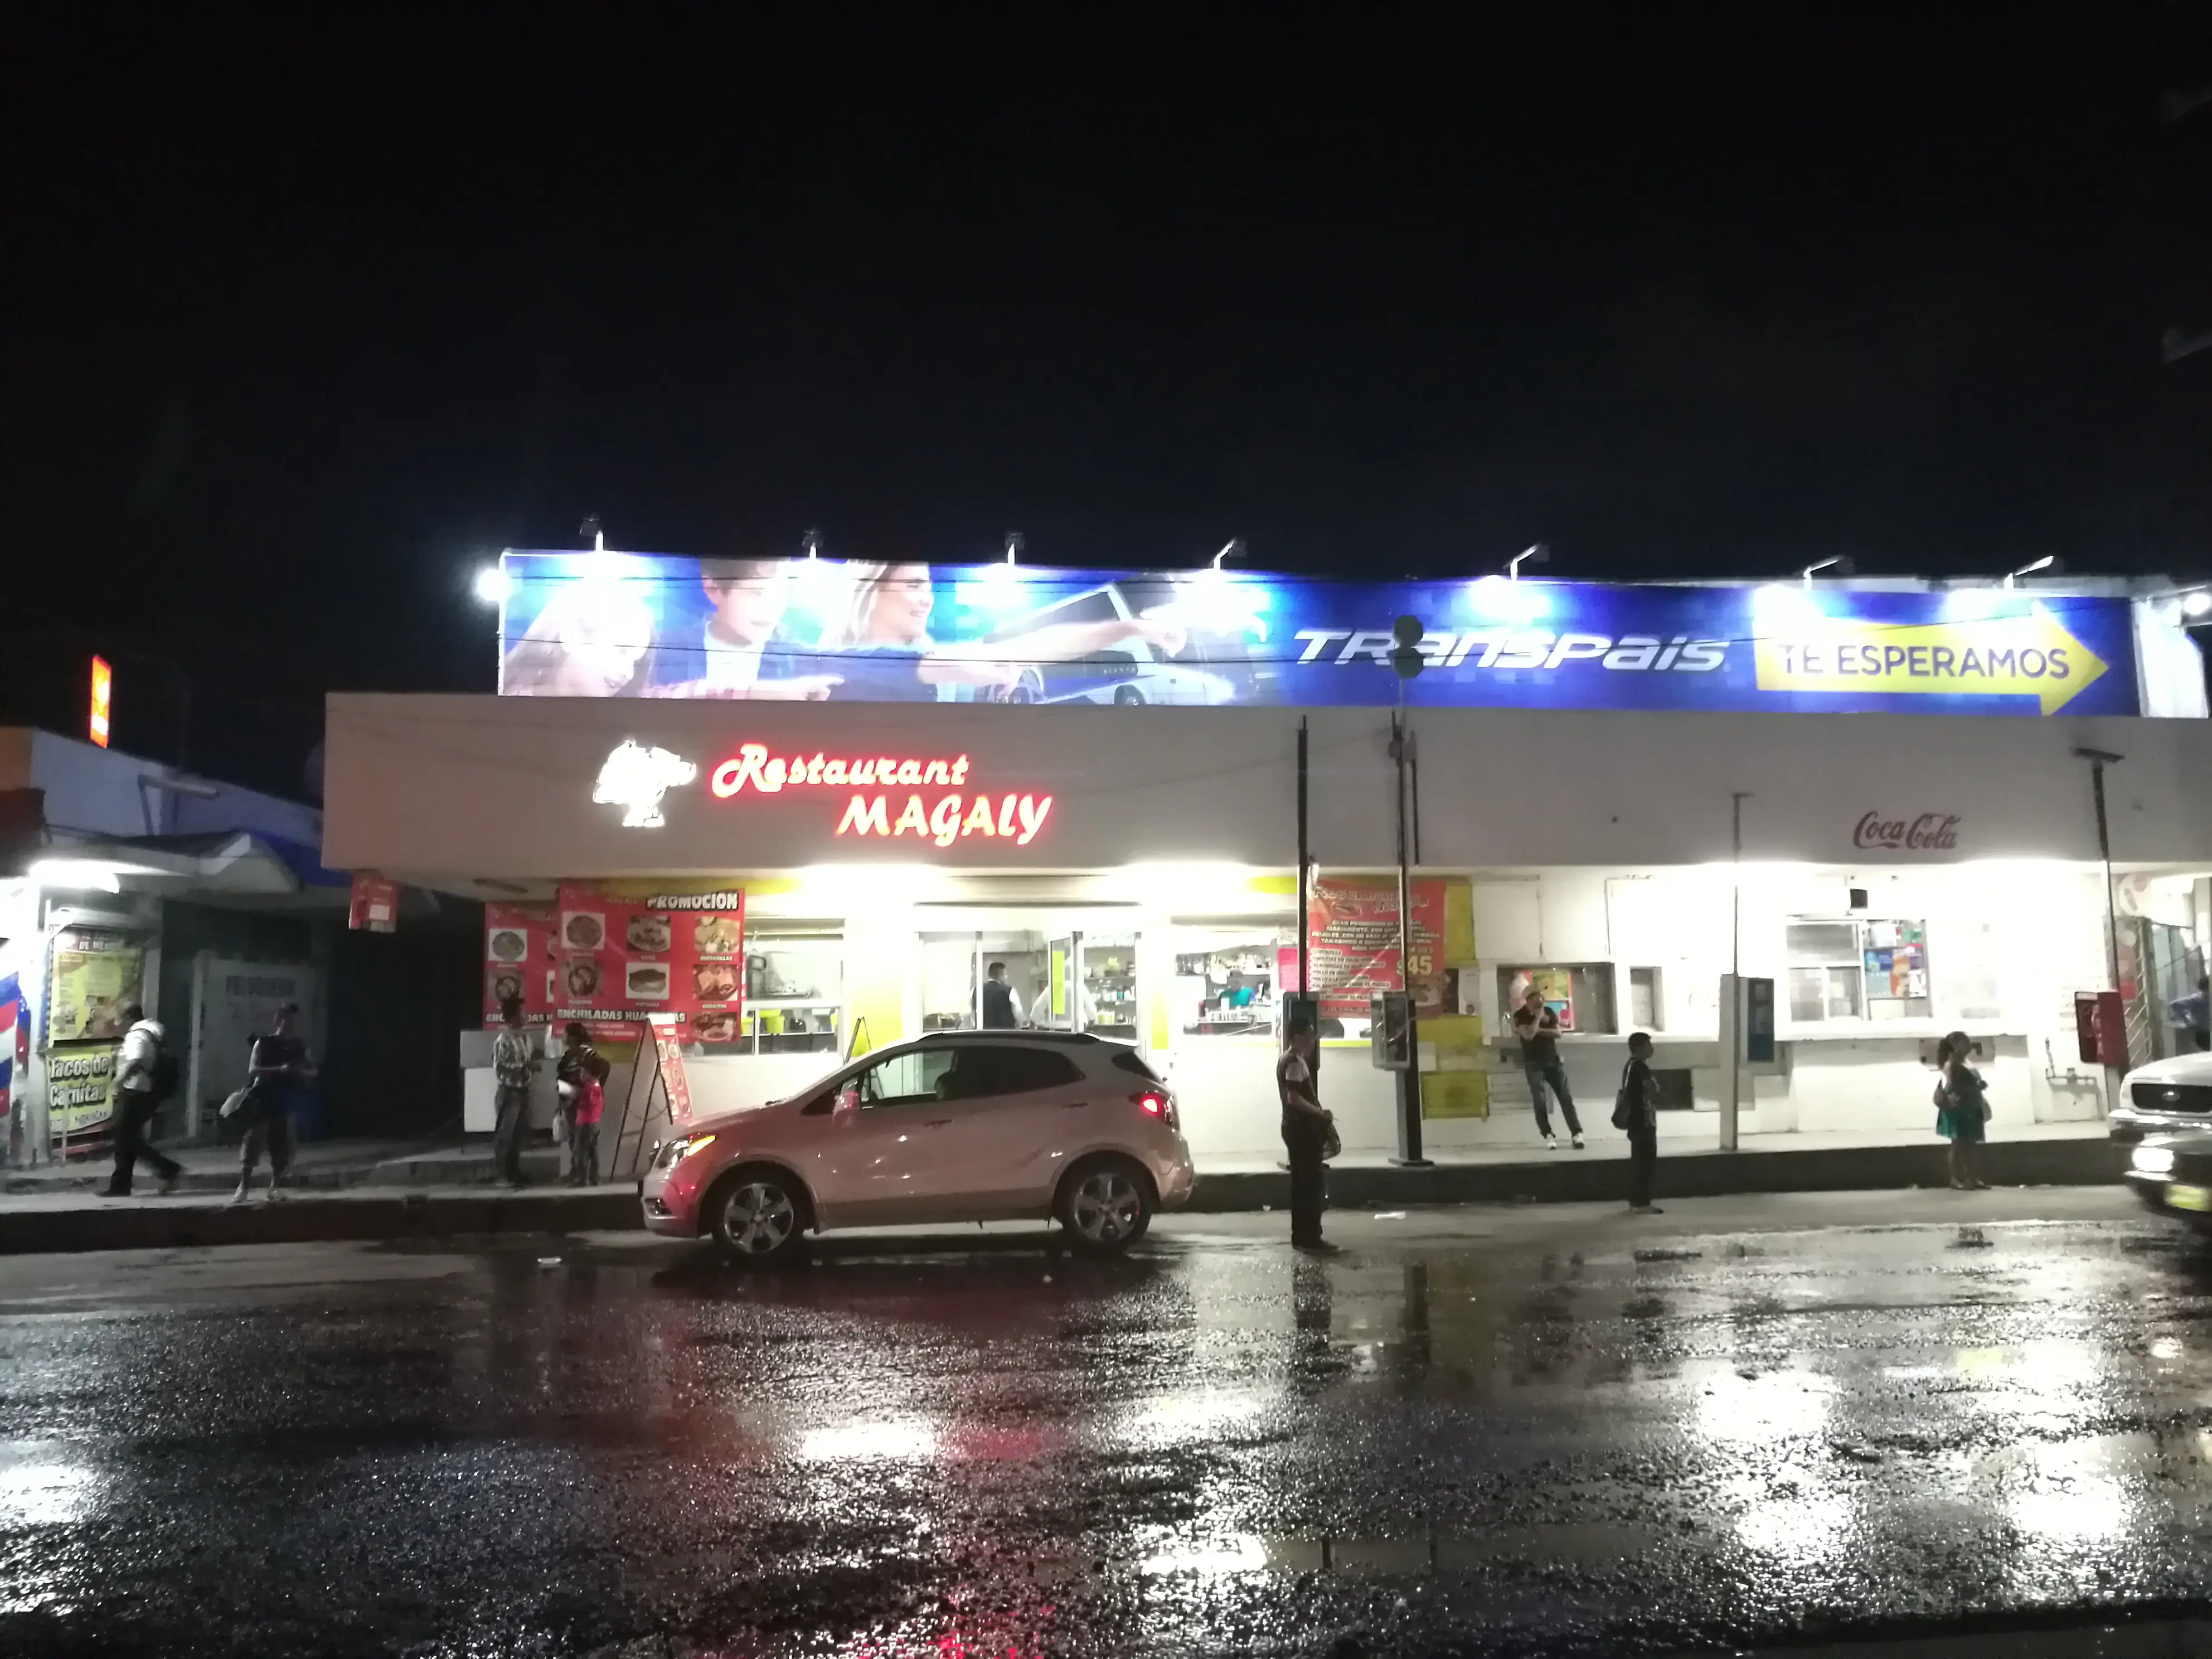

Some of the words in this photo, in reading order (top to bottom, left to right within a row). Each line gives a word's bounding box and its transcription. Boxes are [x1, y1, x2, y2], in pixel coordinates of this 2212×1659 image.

[1778, 644, 1823, 674] TE
[1839, 645, 2070, 680] ESPERAMOS
[711, 743, 969, 798] Restaurant
[1853, 810, 1905, 849] Coca
[1906, 812, 1962, 850] Cola
[557, 1009, 623, 1020] ENCHILADAS
[50, 1059, 90, 1079] Tacos
[93, 1055, 110, 1075] de
